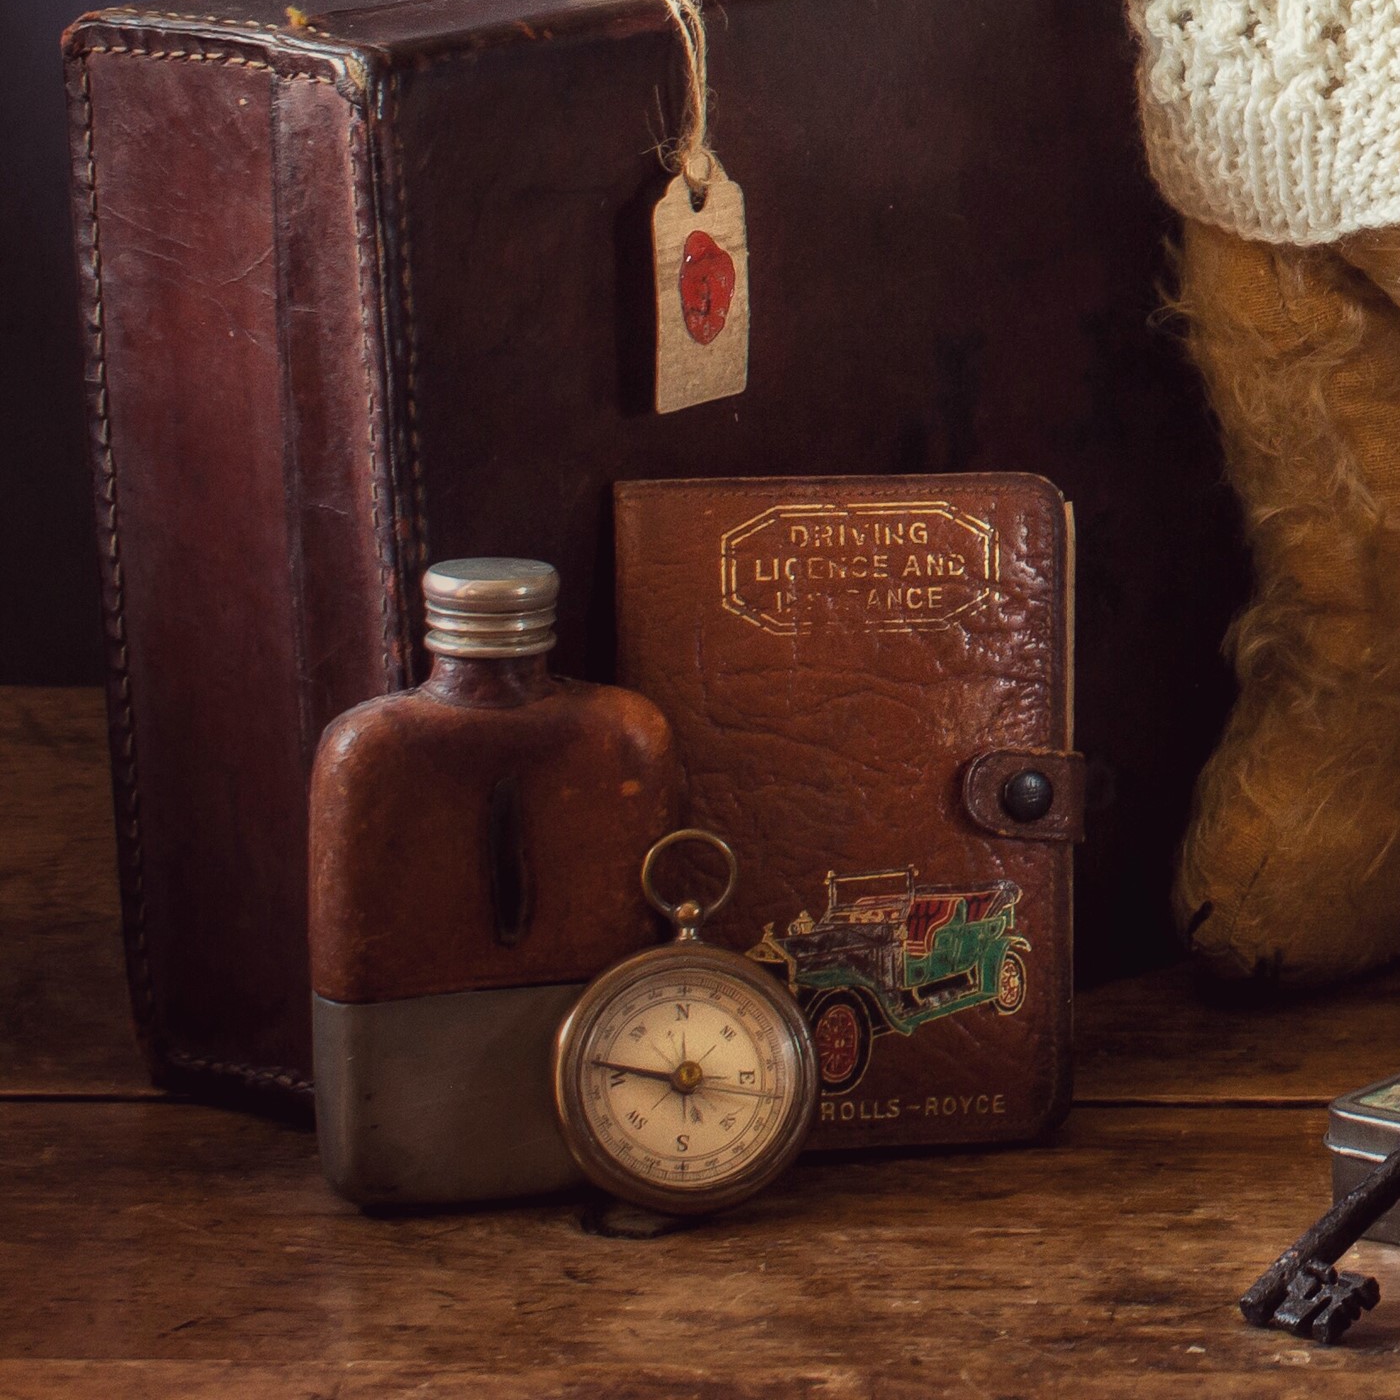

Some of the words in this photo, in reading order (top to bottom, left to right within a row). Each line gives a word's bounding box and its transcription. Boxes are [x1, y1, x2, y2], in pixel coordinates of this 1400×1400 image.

[791, 522, 928, 547] DRIVING
[756, 555, 888, 581] LICENCE
[902, 553, 966, 578] AND
[777, 587, 943, 613] INANCE
[675, 1003, 691, 1021] N
[720, 1024, 737, 1042] NE
[739, 1070, 755, 1085] E
[627, 1109, 648, 1130] SW
[676, 1134, 690, 1152] S
